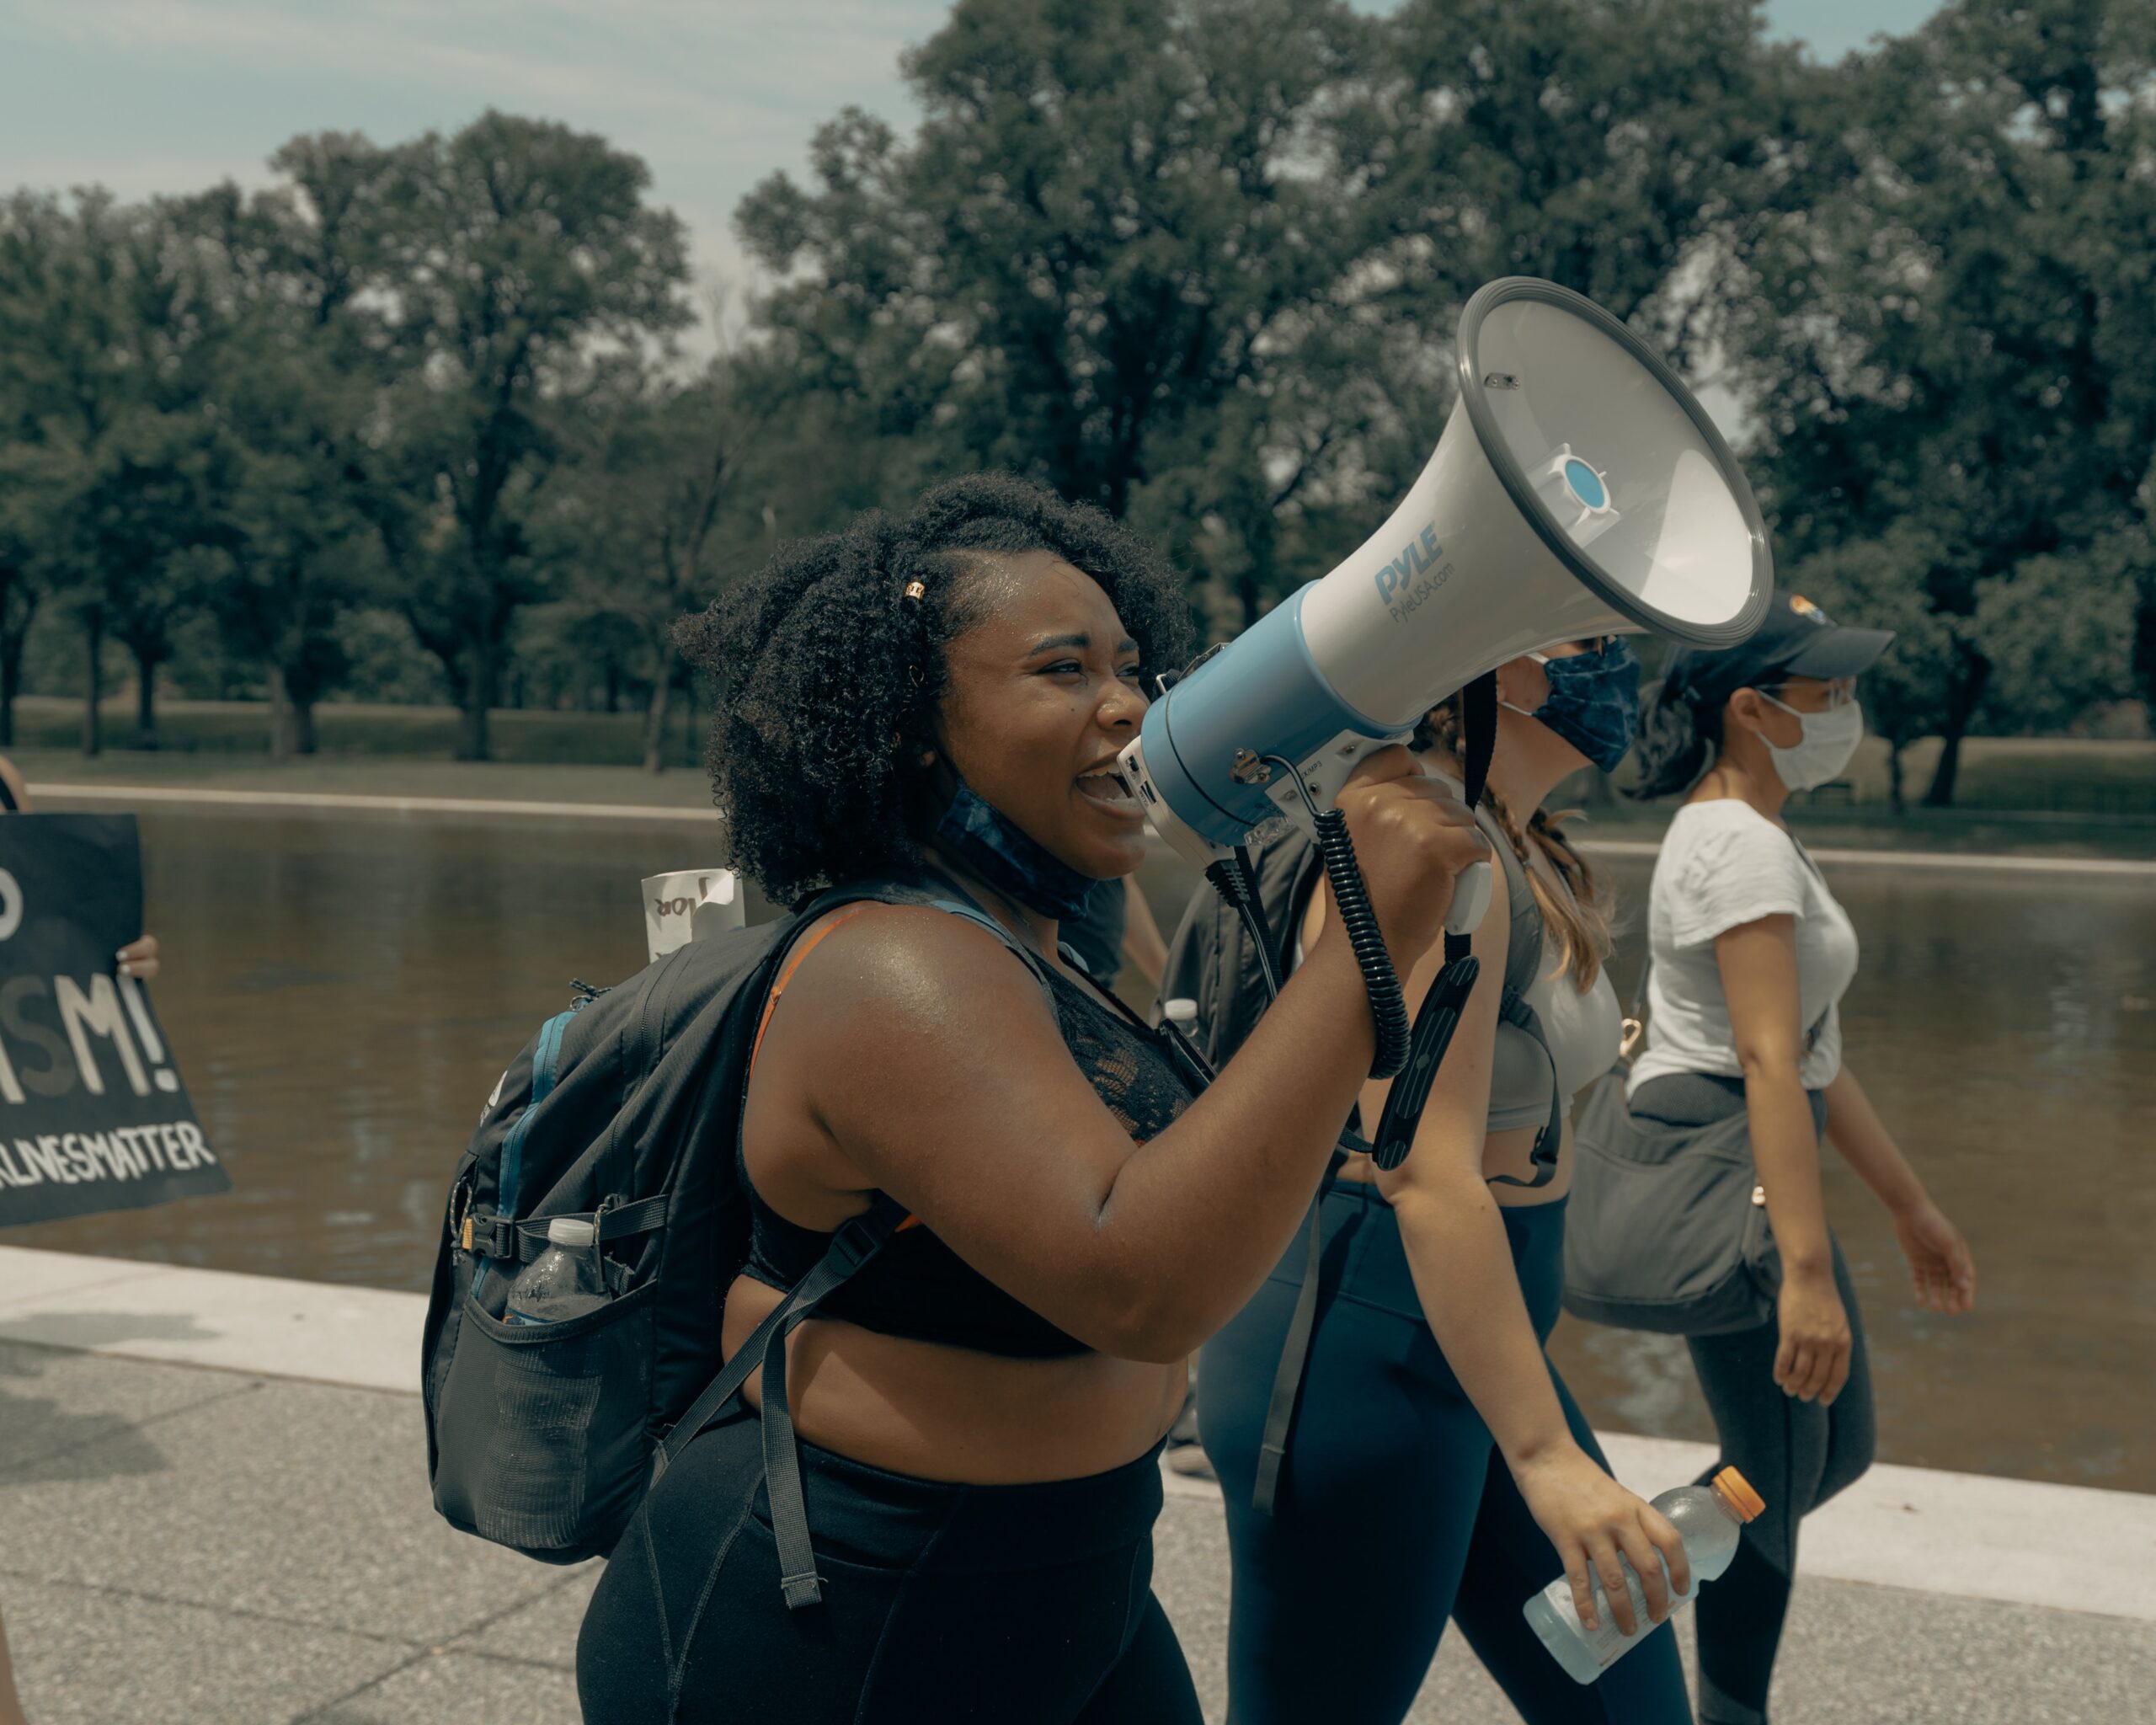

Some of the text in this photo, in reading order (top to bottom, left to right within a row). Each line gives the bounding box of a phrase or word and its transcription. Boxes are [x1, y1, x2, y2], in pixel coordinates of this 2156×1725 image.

[1374, 520, 1444, 606] PYLE
[1390, 563, 1455, 623] PyleUSA.com
[0, 1121, 216, 1190] LIVESMATTER
